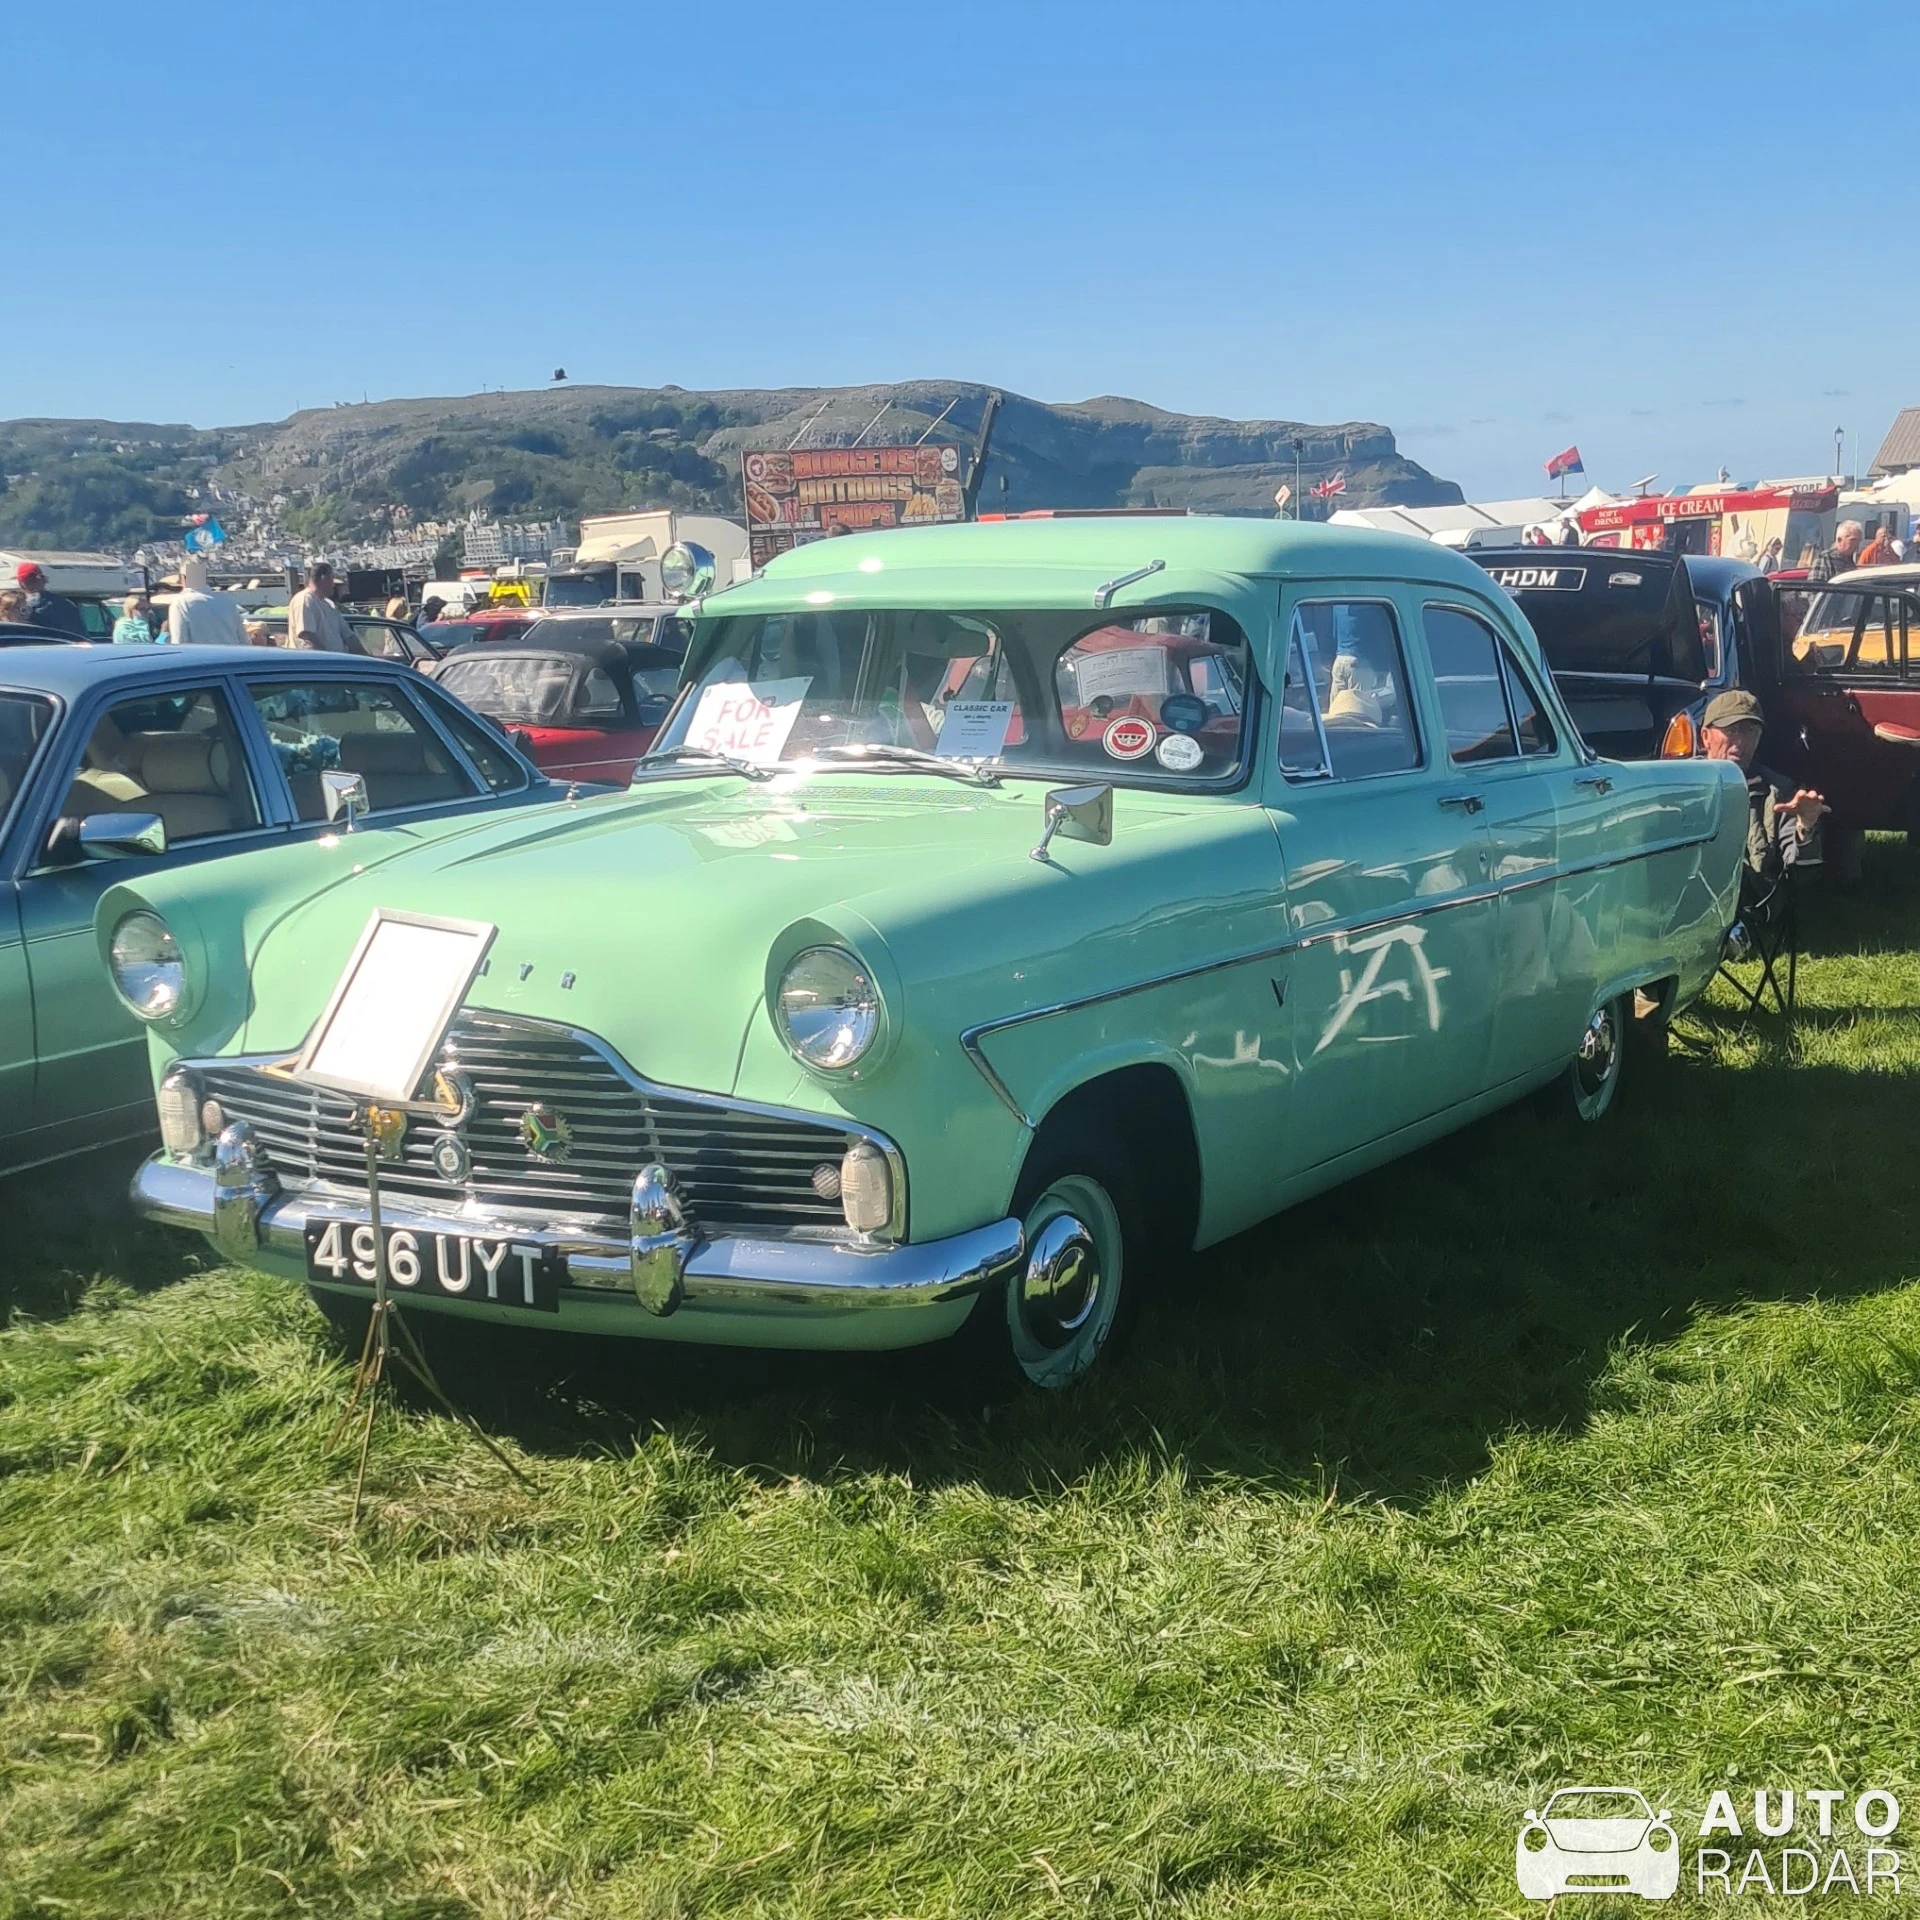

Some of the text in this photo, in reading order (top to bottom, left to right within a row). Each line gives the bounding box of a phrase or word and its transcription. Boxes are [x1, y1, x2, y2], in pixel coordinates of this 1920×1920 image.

[793, 449, 916, 479] BURGERS
[800, 476, 913, 506] HOTDOGS
[821, 503, 896, 530] CHIPS
[1594, 516, 1623, 526] DRINKS
[1656, 499, 1724, 517] ICE CREAM
[717, 696, 776, 724] FOR
[953, 704, 1008, 713] CLASSIC CAR
[700, 722, 775, 752] SALE
[313, 1222, 543, 1305] 496 UYT
